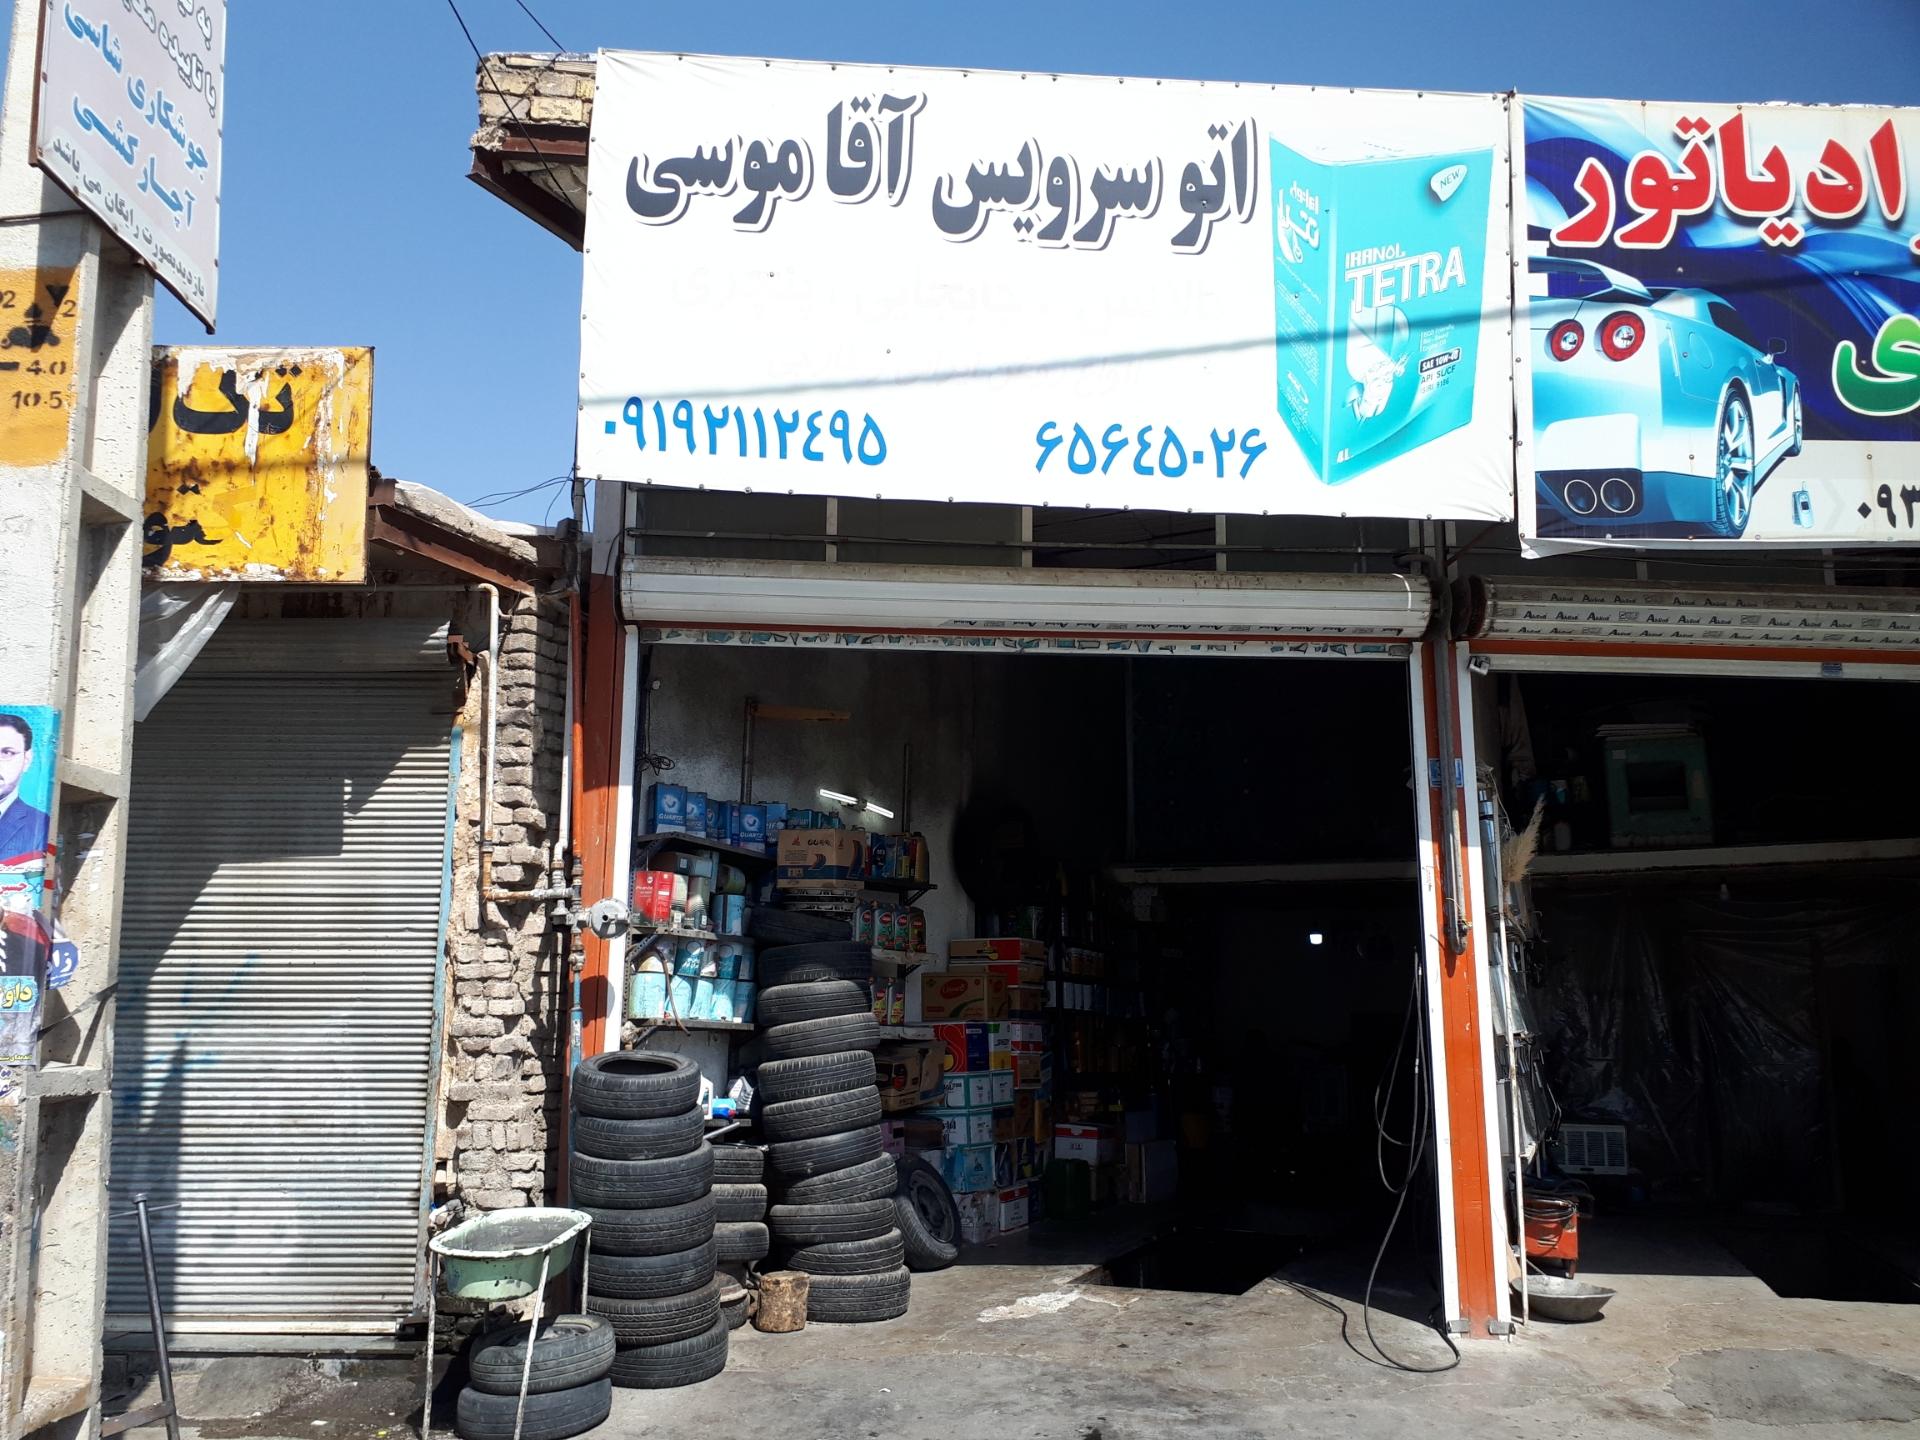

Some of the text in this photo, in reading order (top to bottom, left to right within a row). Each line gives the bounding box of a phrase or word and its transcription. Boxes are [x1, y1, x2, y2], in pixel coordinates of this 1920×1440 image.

[64, 2, 123, 76] شاسی
[127, 74, 209, 182] جوشکاری
[625, 91, 1258, 255] اتو سرویس آقا موسی
[1439, 168, 1461, 190] NEW
[1550, 112, 1920, 256] ادیاتور
[1345, 243, 1407, 270] IRANOL
[1345, 246, 1467, 315] TETRA
[62, 299, 77, 317] 2
[26, 359, 67, 376] 4.0
[1421, 359, 1435, 371] SAE
[1420, 373, 1434, 385] API
[11, 390, 63, 410] 10.5
